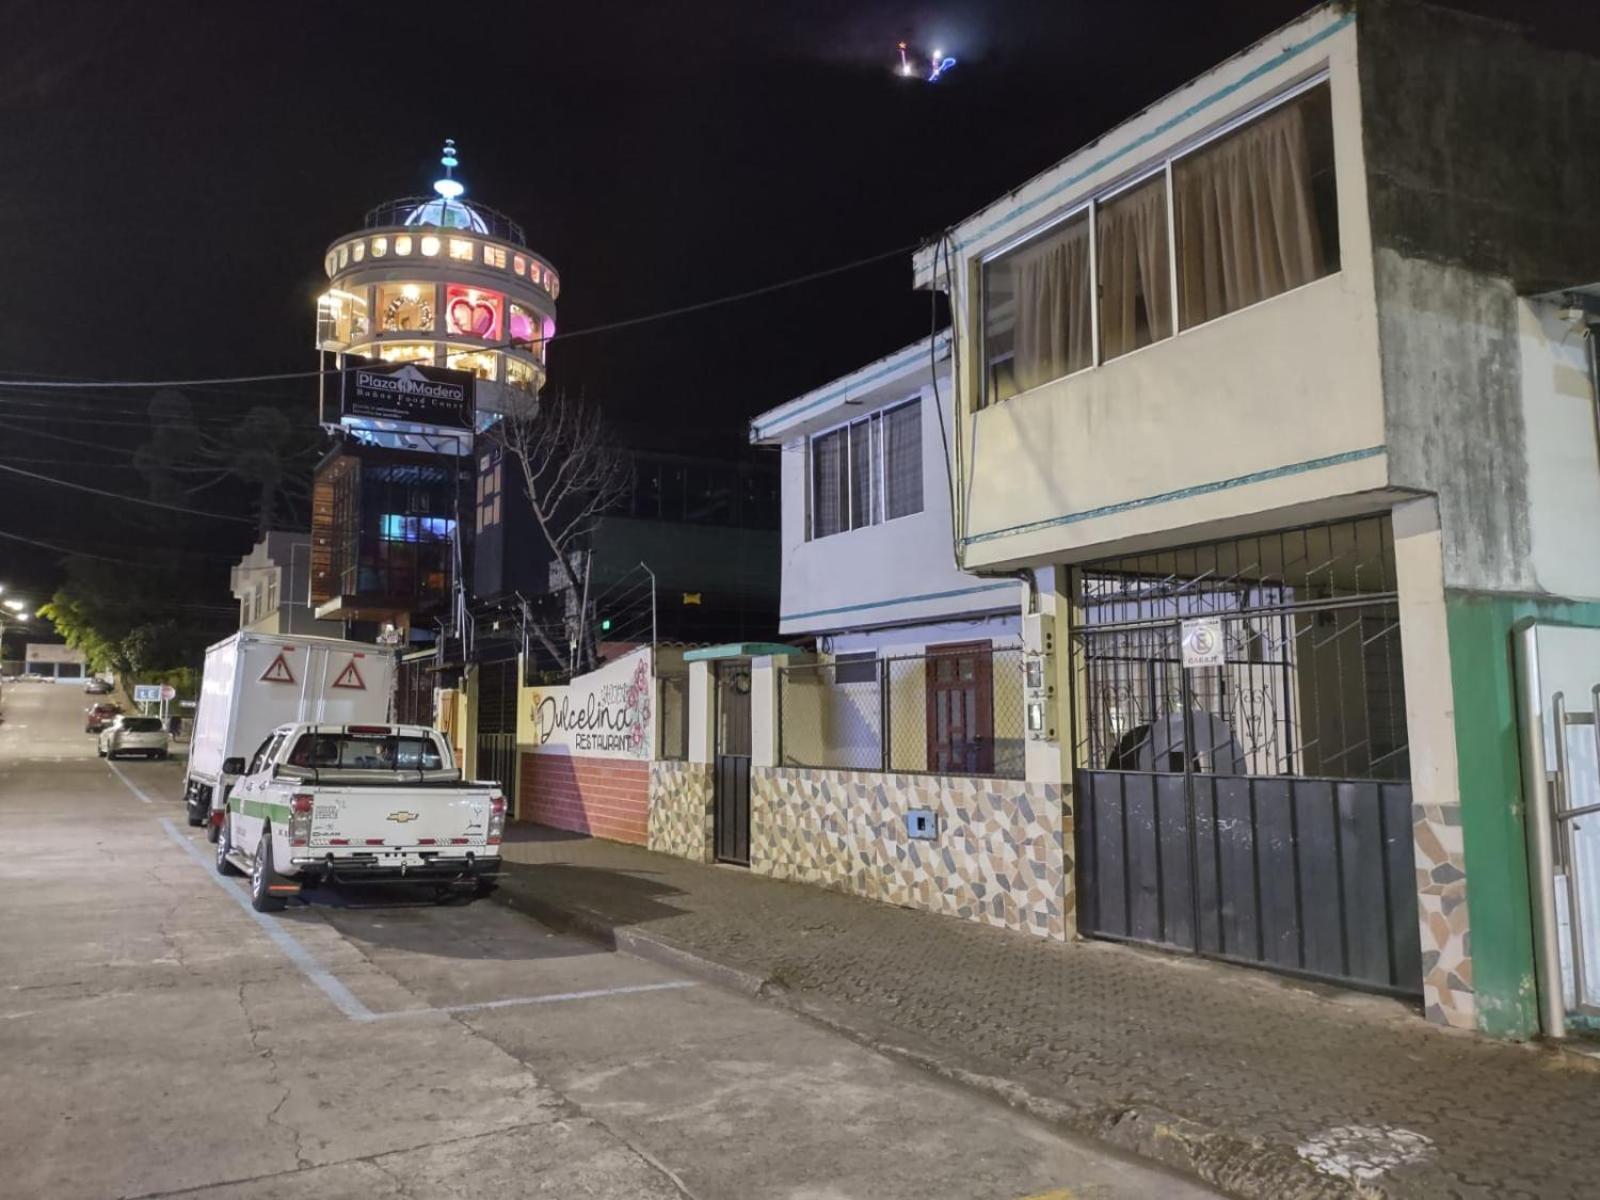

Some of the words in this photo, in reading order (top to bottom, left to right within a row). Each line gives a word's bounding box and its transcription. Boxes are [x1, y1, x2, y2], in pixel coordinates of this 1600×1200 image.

[359, 374, 397, 390] Plaza
[412, 381, 462, 399] Madero
[537, 692, 633, 745] Dulcelina
